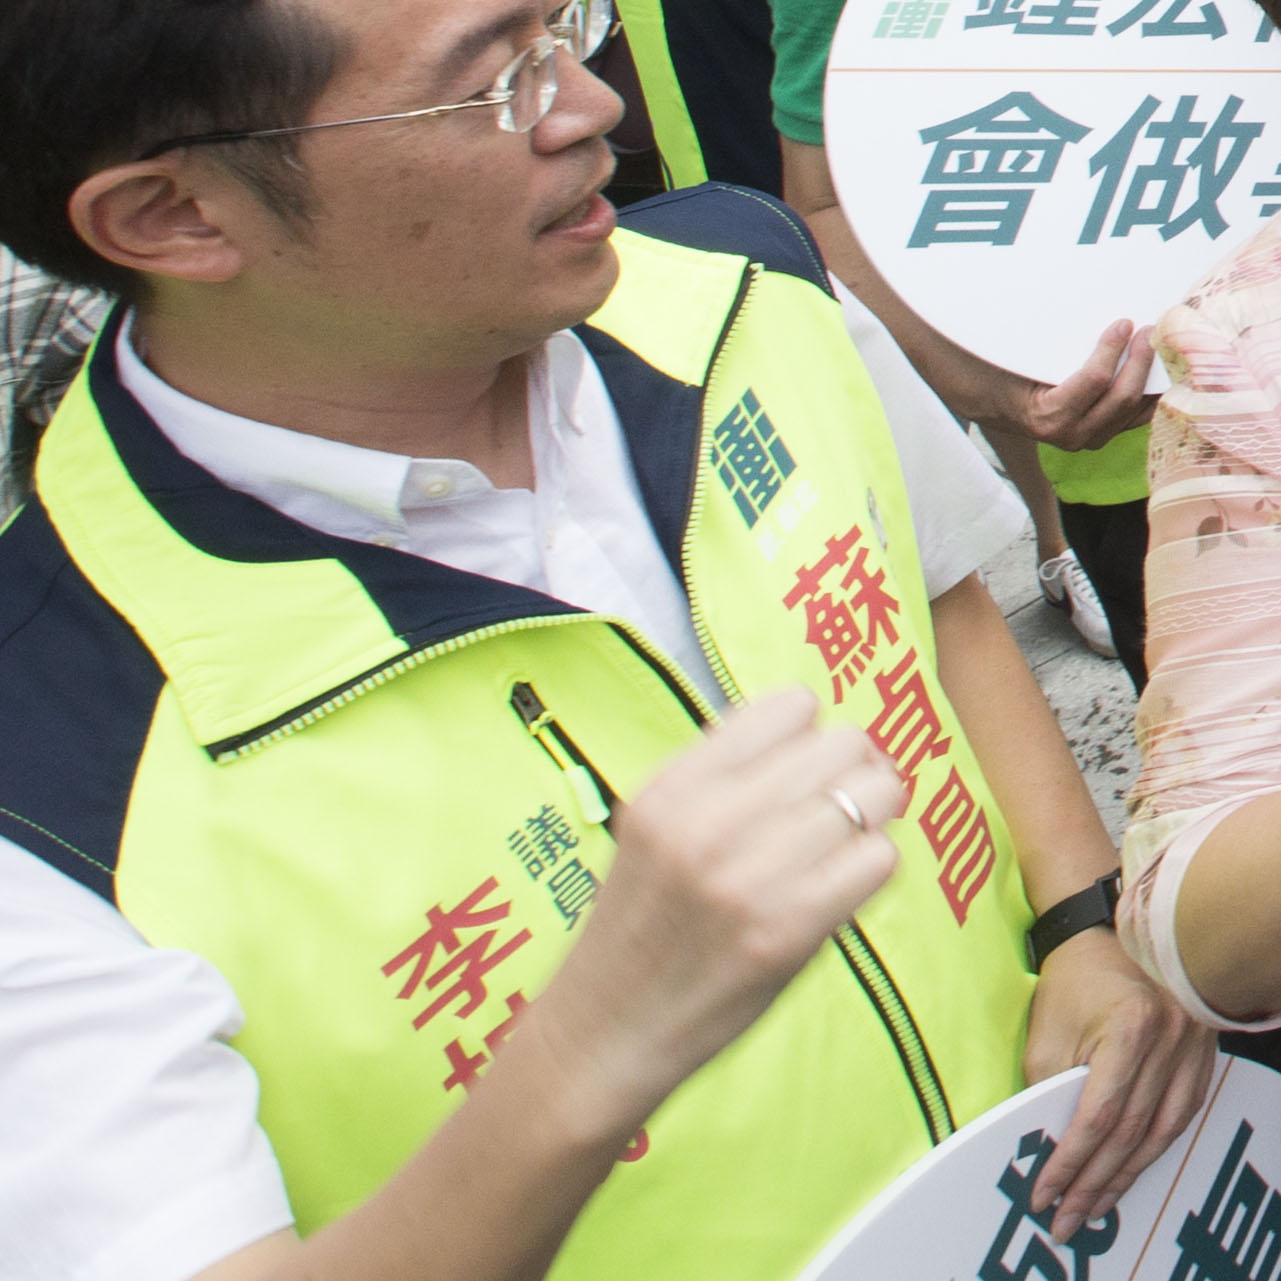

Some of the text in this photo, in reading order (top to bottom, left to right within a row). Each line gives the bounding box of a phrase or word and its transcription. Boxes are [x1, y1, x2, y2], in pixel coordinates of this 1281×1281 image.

[782, 524, 996, 928] 蘇貞昌
[508, 803, 604, 932] 議員
